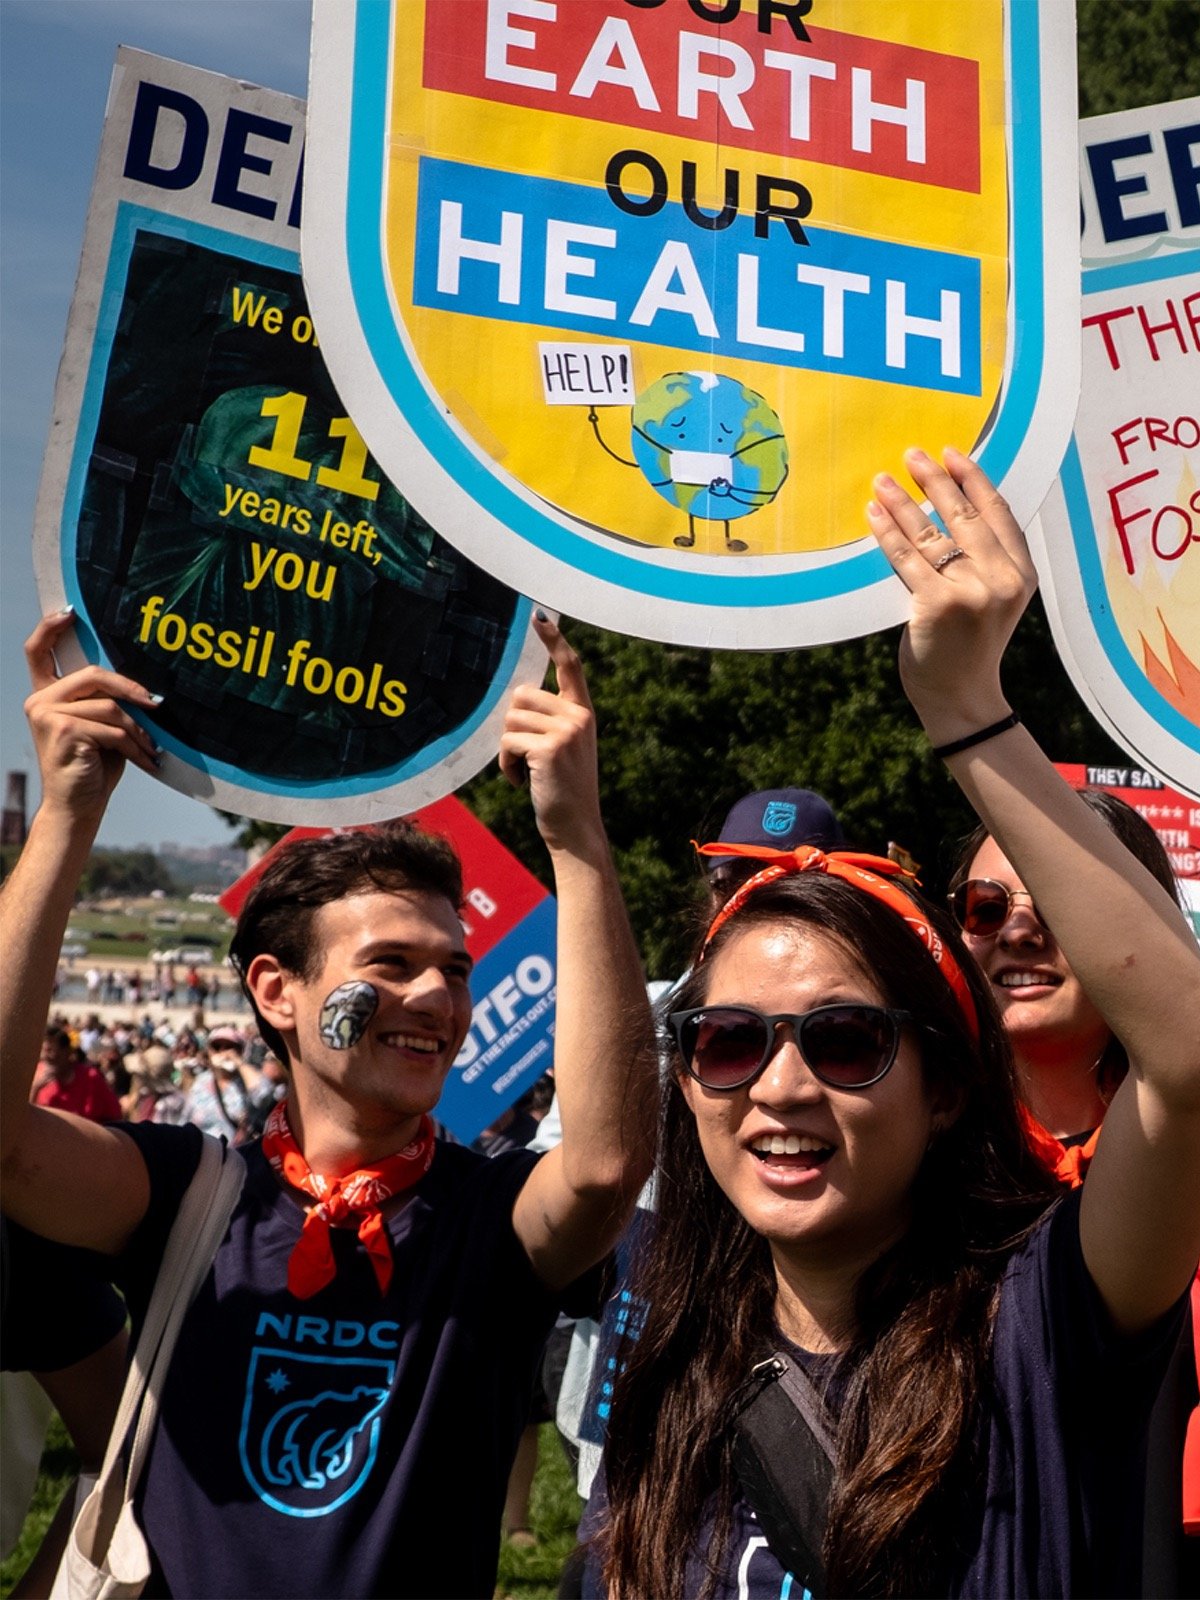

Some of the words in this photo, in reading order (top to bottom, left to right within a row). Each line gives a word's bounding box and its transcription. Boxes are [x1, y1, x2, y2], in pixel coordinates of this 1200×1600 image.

[485, 0, 926, 164] EARTH
[123, 81, 304, 228] DE
[605, 149, 813, 246] OUR
[232, 287, 284, 335] We
[437, 200, 961, 379] HEALTH
[543, 351, 629, 394] HELP!
[248, 391, 381, 501] 11
[218, 483, 313, 535] years
[319, 509, 383, 566] left,
[243, 541, 337, 602] you
[139, 596, 276, 678] fossil
[285, 639, 408, 718] fools
[1087, 767, 1127, 785] THEY
[255, 1311, 401, 1350] NRDC
